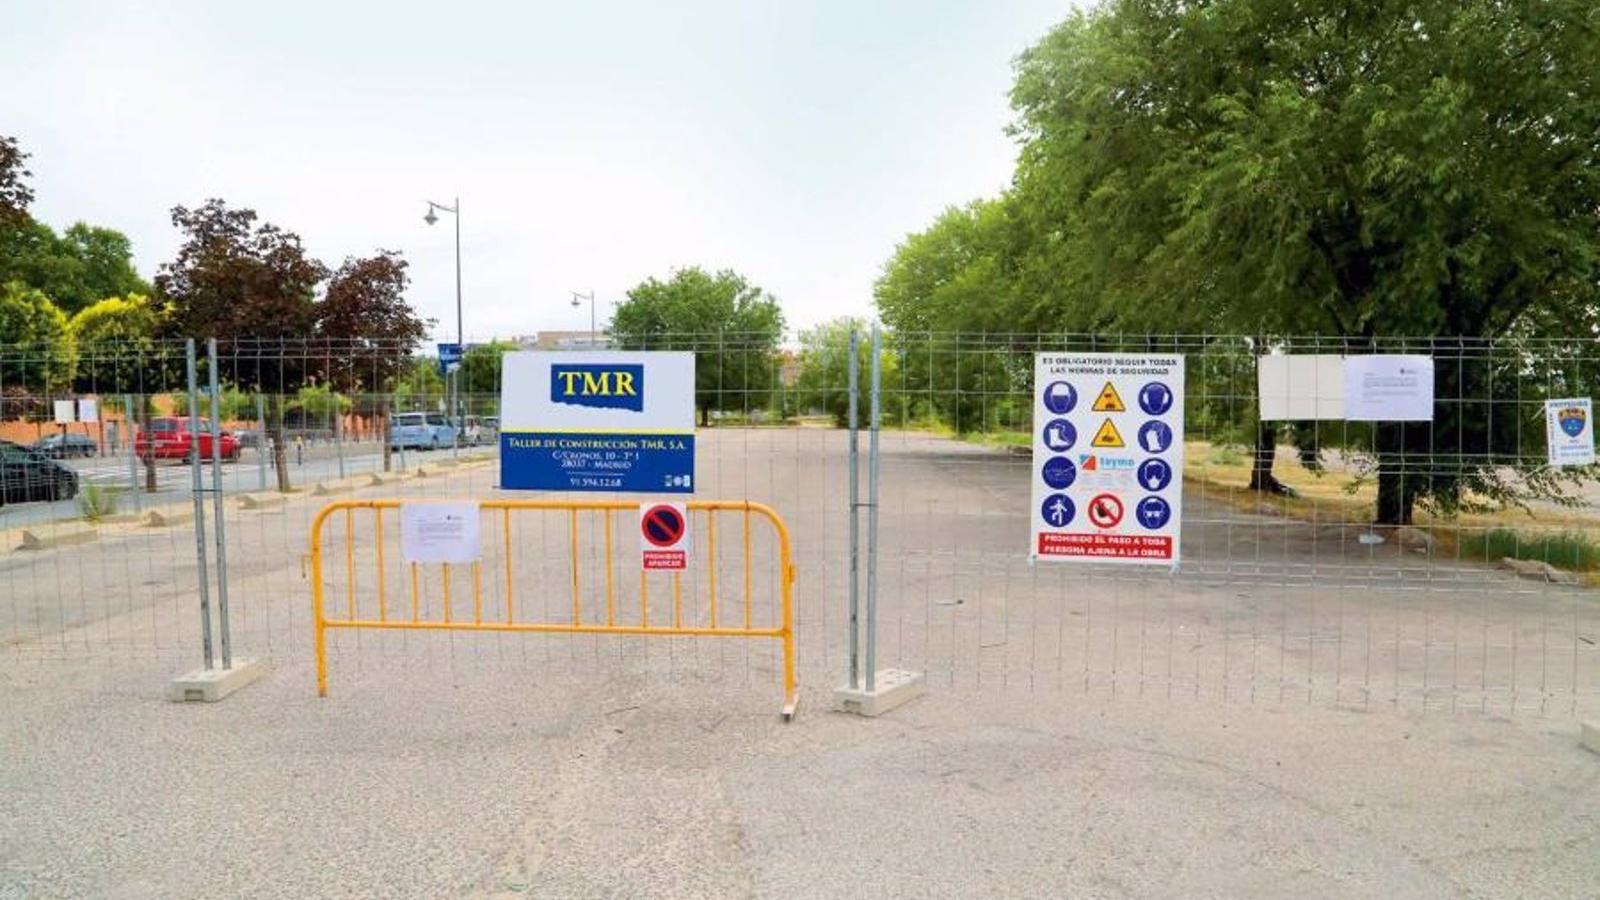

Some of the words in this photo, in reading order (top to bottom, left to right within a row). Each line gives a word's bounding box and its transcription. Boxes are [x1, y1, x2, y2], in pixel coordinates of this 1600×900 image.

[1055, 357, 1112, 366] OBLIGATORIO
[1115, 358, 1146, 366] SEGUIR
[1149, 358, 1177, 367] TODAS
[1050, 366, 1066, 374] LAS
[1068, 366, 1105, 375] NORMAS
[1107, 367, 1118, 375] DE
[1119, 368, 1169, 376] SEGURIDAD
[558, 371, 637, 396] TMR
[508, 437, 541, 448] TALLER
[543, 439, 556, 448] DE
[605, 451, 616, 461] 10
[594, 461, 632, 470] MADRID
[1044, 535, 1093, 544] PROHIBIDO
[1095, 536, 1107, 545] EL
[1108, 537, 1132, 545] PASO
[1133, 537, 1140, 545] A
[1142, 537, 1166, 546] TODA
[645, 552, 683, 560] PROHIBIDO
[1044, 545, 1085, 555] PERSONA
[1118, 547, 1126, 555] A
[1127, 548, 1139, 556] LA
[1141, 548, 1167, 557] OBRA
